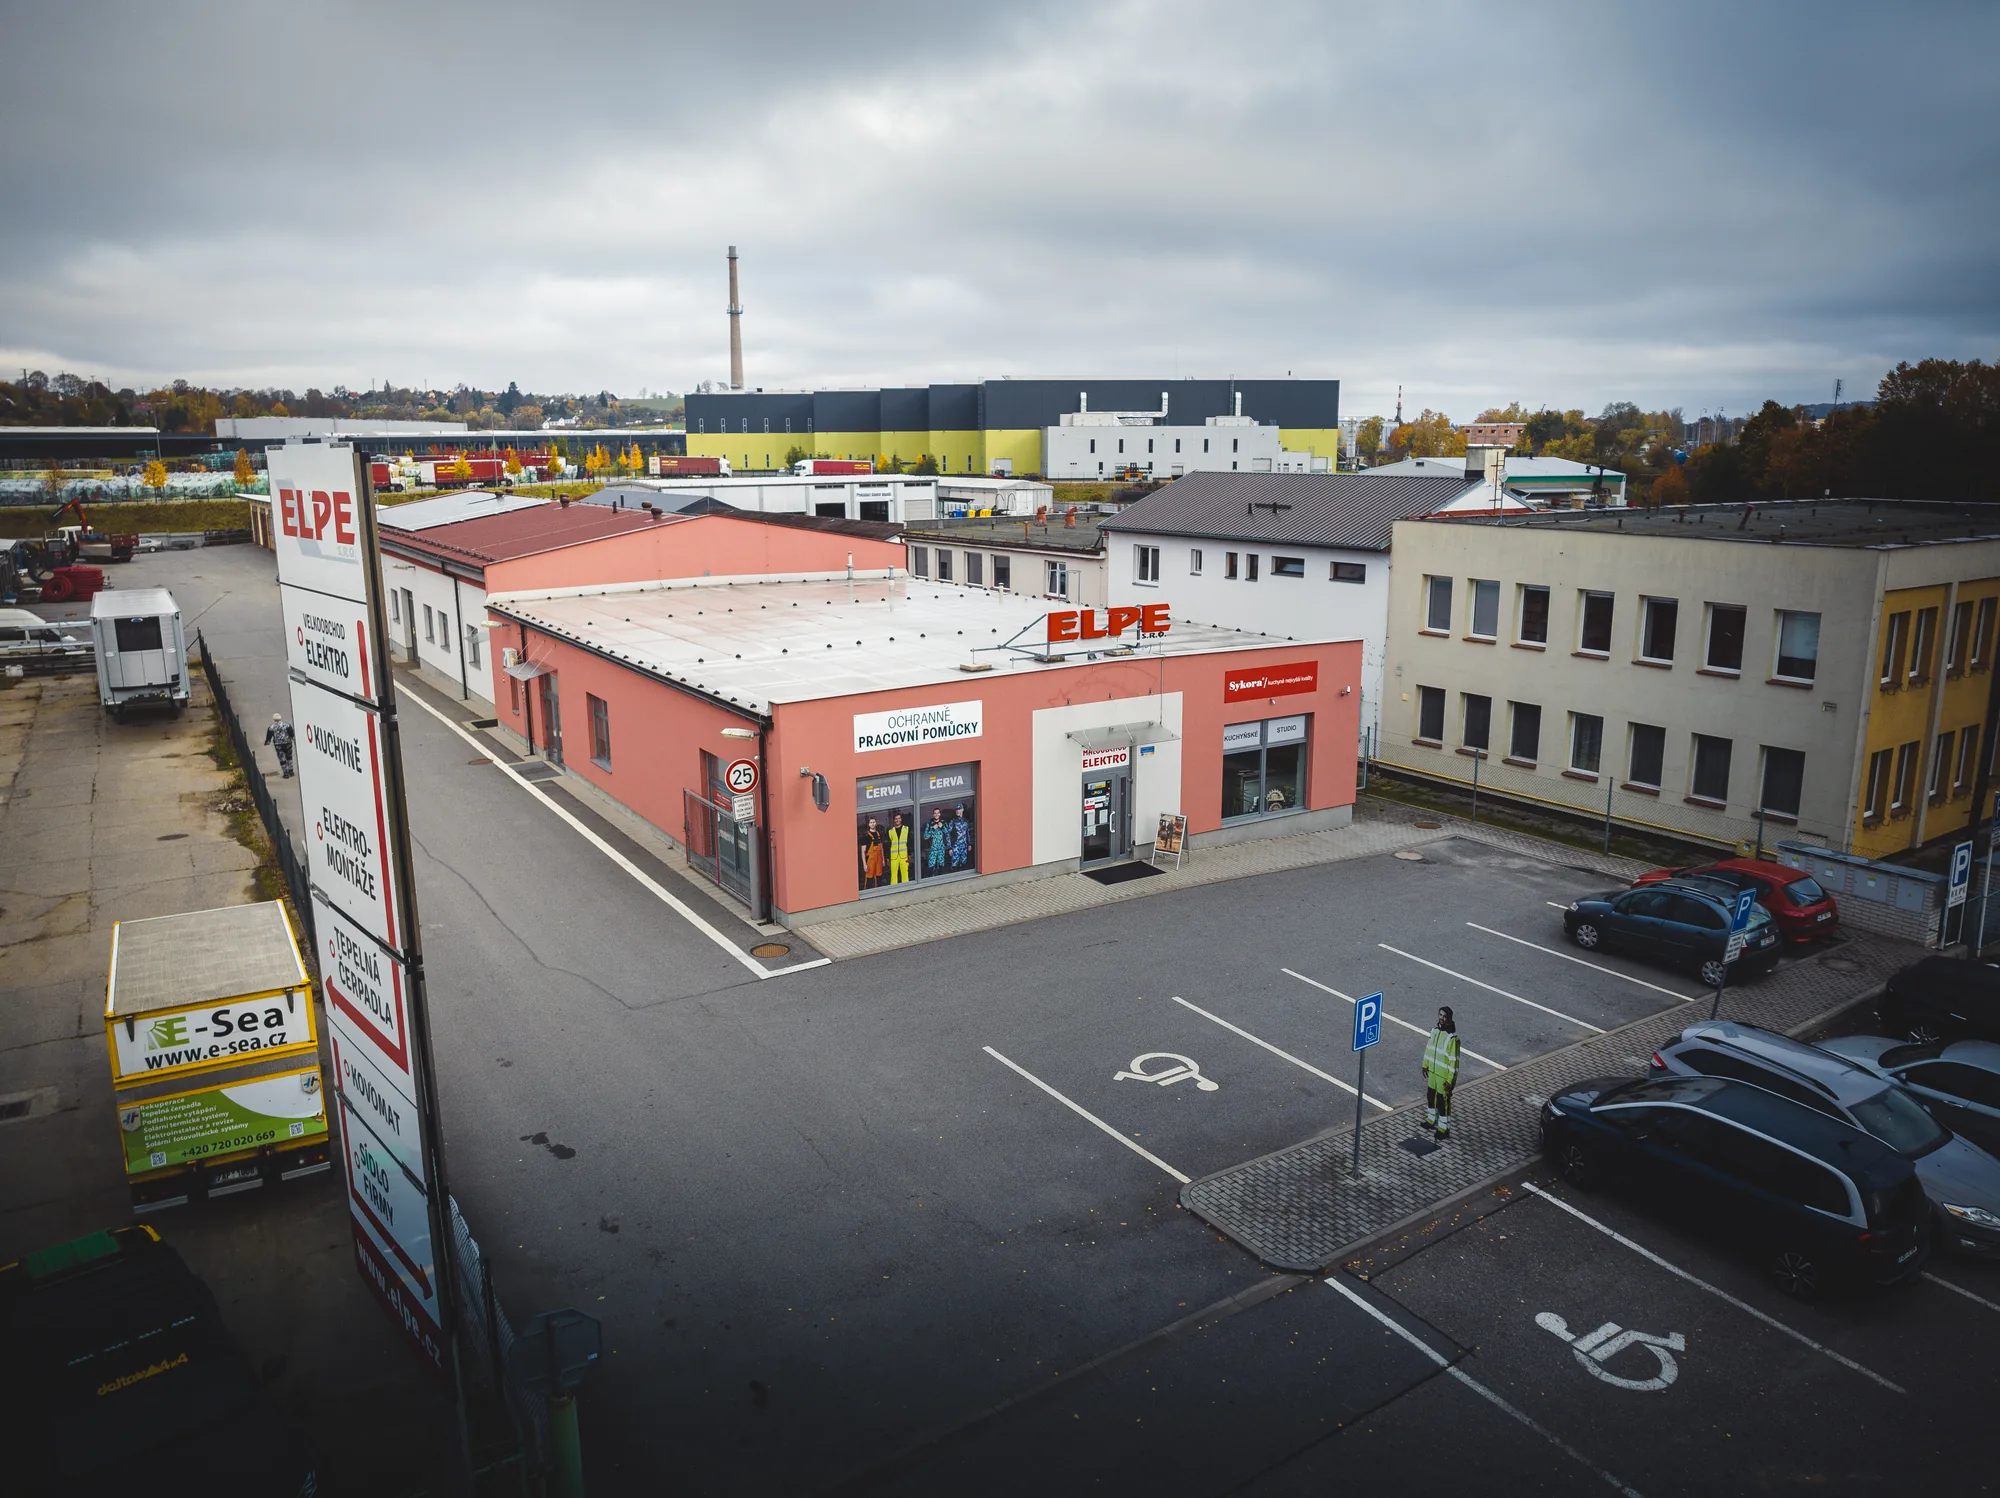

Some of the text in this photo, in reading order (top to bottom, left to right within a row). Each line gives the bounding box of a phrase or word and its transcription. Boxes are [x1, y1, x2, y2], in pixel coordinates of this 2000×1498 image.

[279, 489, 356, 545] ELPE
[302, 613, 345, 640] VELKOOBCHOD
[1047, 603, 1171, 642] ELPE
[305, 640, 349, 678] ELEKTRO
[888, 707, 951, 729] OCHRANNÉ
[1276, 724, 1297, 733] STUDIO
[858, 720, 979, 748] PRACOVNÍ POMŮCKY
[313, 725, 362, 774] KUCHYNĚ
[1082, 753, 1127, 768] ELEKTRO
[733, 768, 752, 785] 25
[929, 775, 964, 790] ČERVA
[865, 785, 902, 799] ČERVA
[322, 806, 372, 858] ELEKTRO-
[326, 843, 377, 901] MONTÁŽE
[1954, 848, 1969, 884] P
[1737, 896, 1751, 920] P
[334, 926, 382, 987] TEPELNÁ
[338, 956, 393, 1030] ČERPADLA
[1360, 1002, 1376, 1033] P
[145, 1031, 288, 1070] www.e-sea.cz
[140, 1098, 185, 1111] Rekuperace
[141, 1101, 202, 1118] Tepelná čerpadla
[350, 1063, 400, 1137] KOVOMAT
[142, 1105, 217, 1126] Podlahové vytápění
[143, 1111, 229, 1133] Solární termické systémy
[144, 1125, 204, 1141] Elektroinstalace
[145, 1138, 171, 1149] Solární
[220, 1122, 249, 1133] systémy
[181, 1130, 276, 1158] +420 720 020 669
[359, 1143, 389, 1194] SÍDLO
[363, 1177, 394, 1226] FIRMY
[356, 1237, 442, 1368] www.elpe.cz
